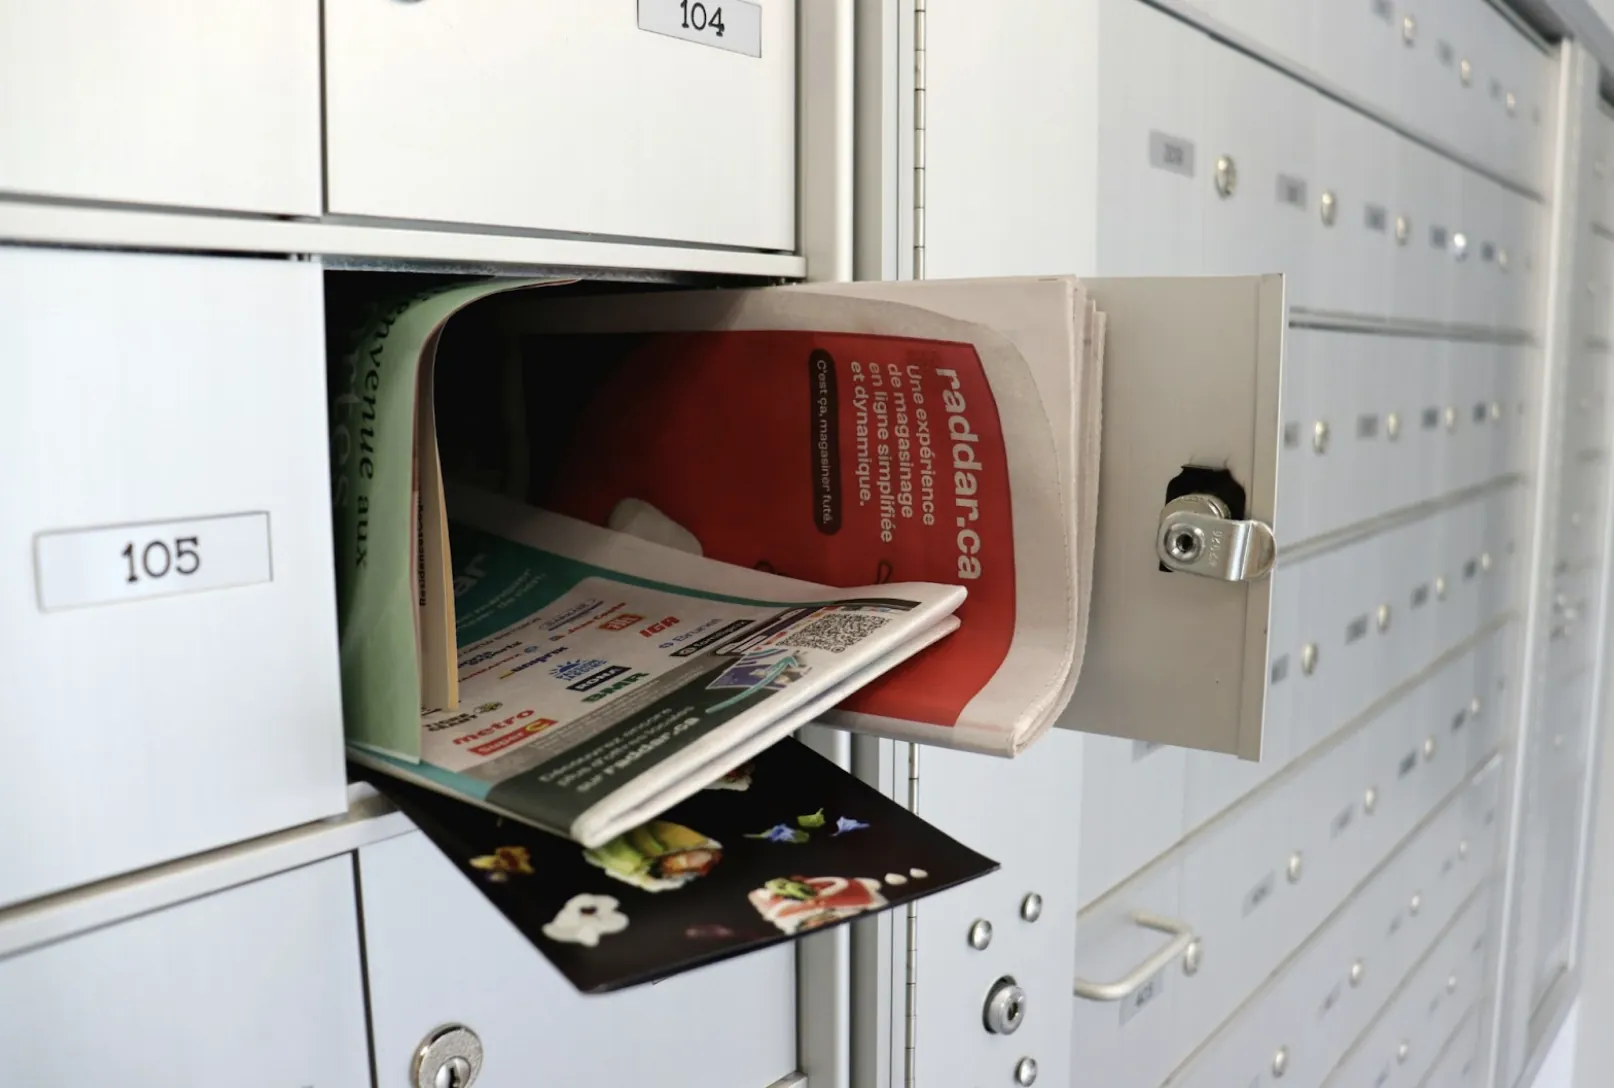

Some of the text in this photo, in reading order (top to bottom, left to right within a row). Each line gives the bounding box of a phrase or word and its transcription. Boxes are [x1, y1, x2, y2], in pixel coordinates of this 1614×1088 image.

[680, 0, 725, 37] 104
[816, 359, 833, 524] C'est ça, magasiner futé.
[850, 361, 872, 507] et dynamique.
[869, 362, 895, 543] en ligne simplifiée
[887, 363, 914, 518] de magasinage
[906, 365, 936, 526] Une expérience
[935, 367, 982, 580] raddar.ca
[120, 536, 202, 584] 105
[355, 494, 370, 569] aux
[639, 615, 681, 638] IGA
[452, 709, 536, 746] metro
